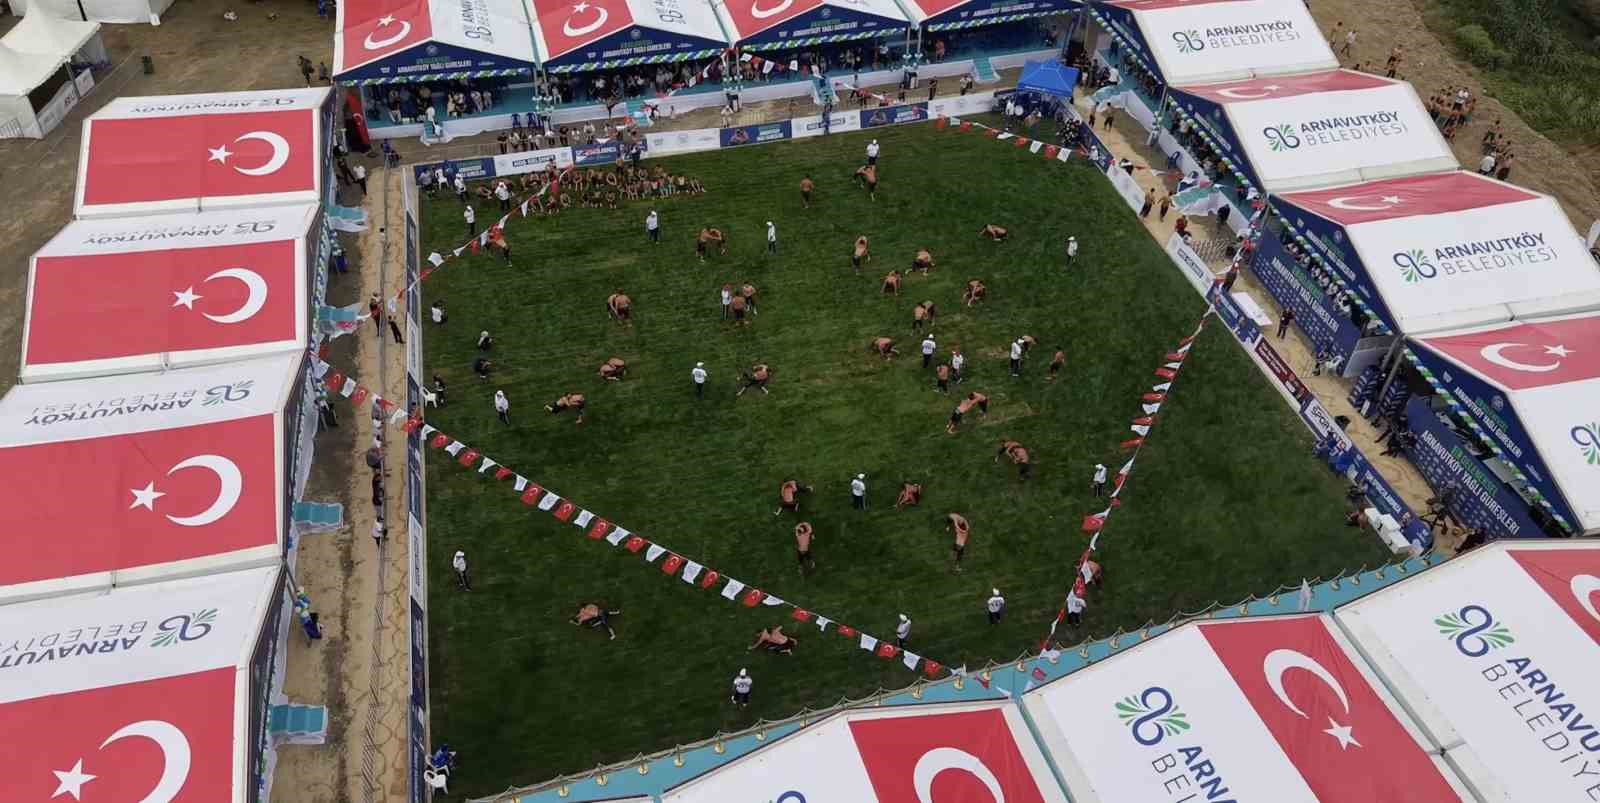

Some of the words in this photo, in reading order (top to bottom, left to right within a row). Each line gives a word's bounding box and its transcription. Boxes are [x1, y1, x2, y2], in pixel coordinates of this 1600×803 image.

[1206, 20, 1293, 38] ARNAVUTKÖY
[1301, 111, 1398, 133] ARNAVUTKÖY
[1435, 232, 1545, 260] ARNAVUTKÖY
[24, 398, 193, 425] ARNAVUTKÖY
[1505, 657, 1600, 755] ARNAVU
